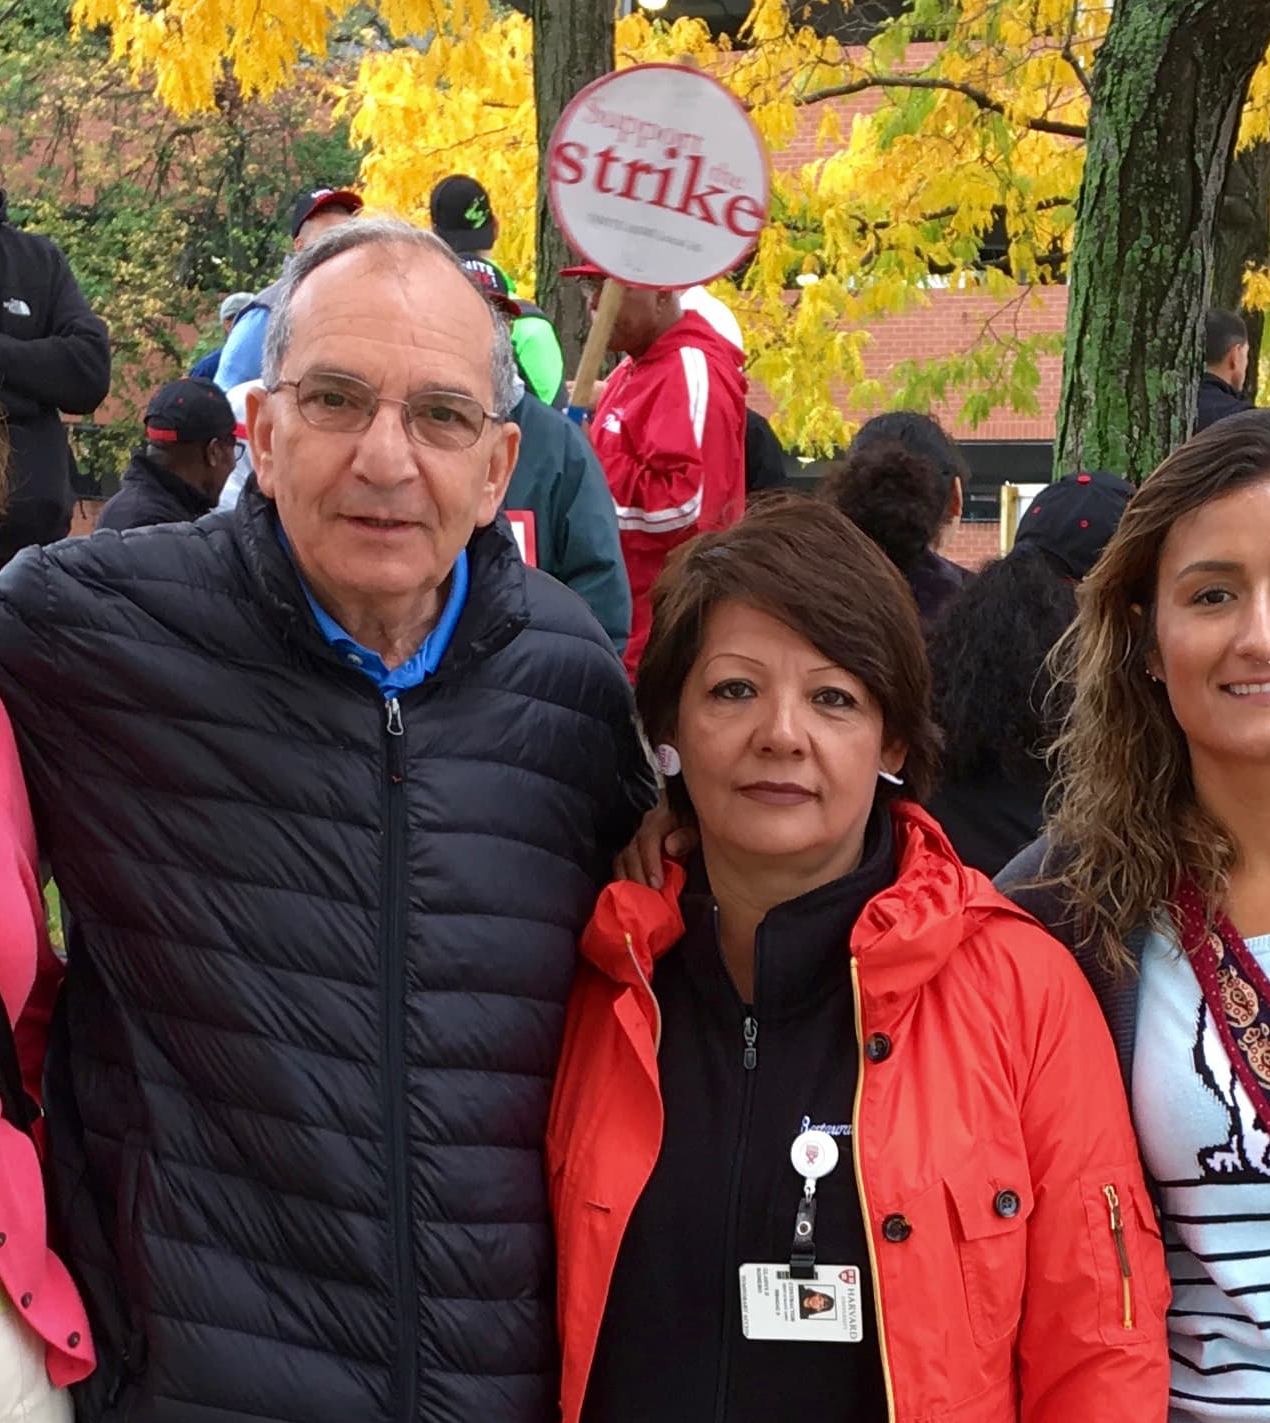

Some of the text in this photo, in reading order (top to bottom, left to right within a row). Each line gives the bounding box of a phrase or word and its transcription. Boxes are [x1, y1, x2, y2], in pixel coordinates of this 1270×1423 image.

[584, 98, 705, 149] Support
[551, 142, 766, 237] strike
[460, 260, 496, 276] NITE
[847, 1288, 858, 1340] HARVARD
